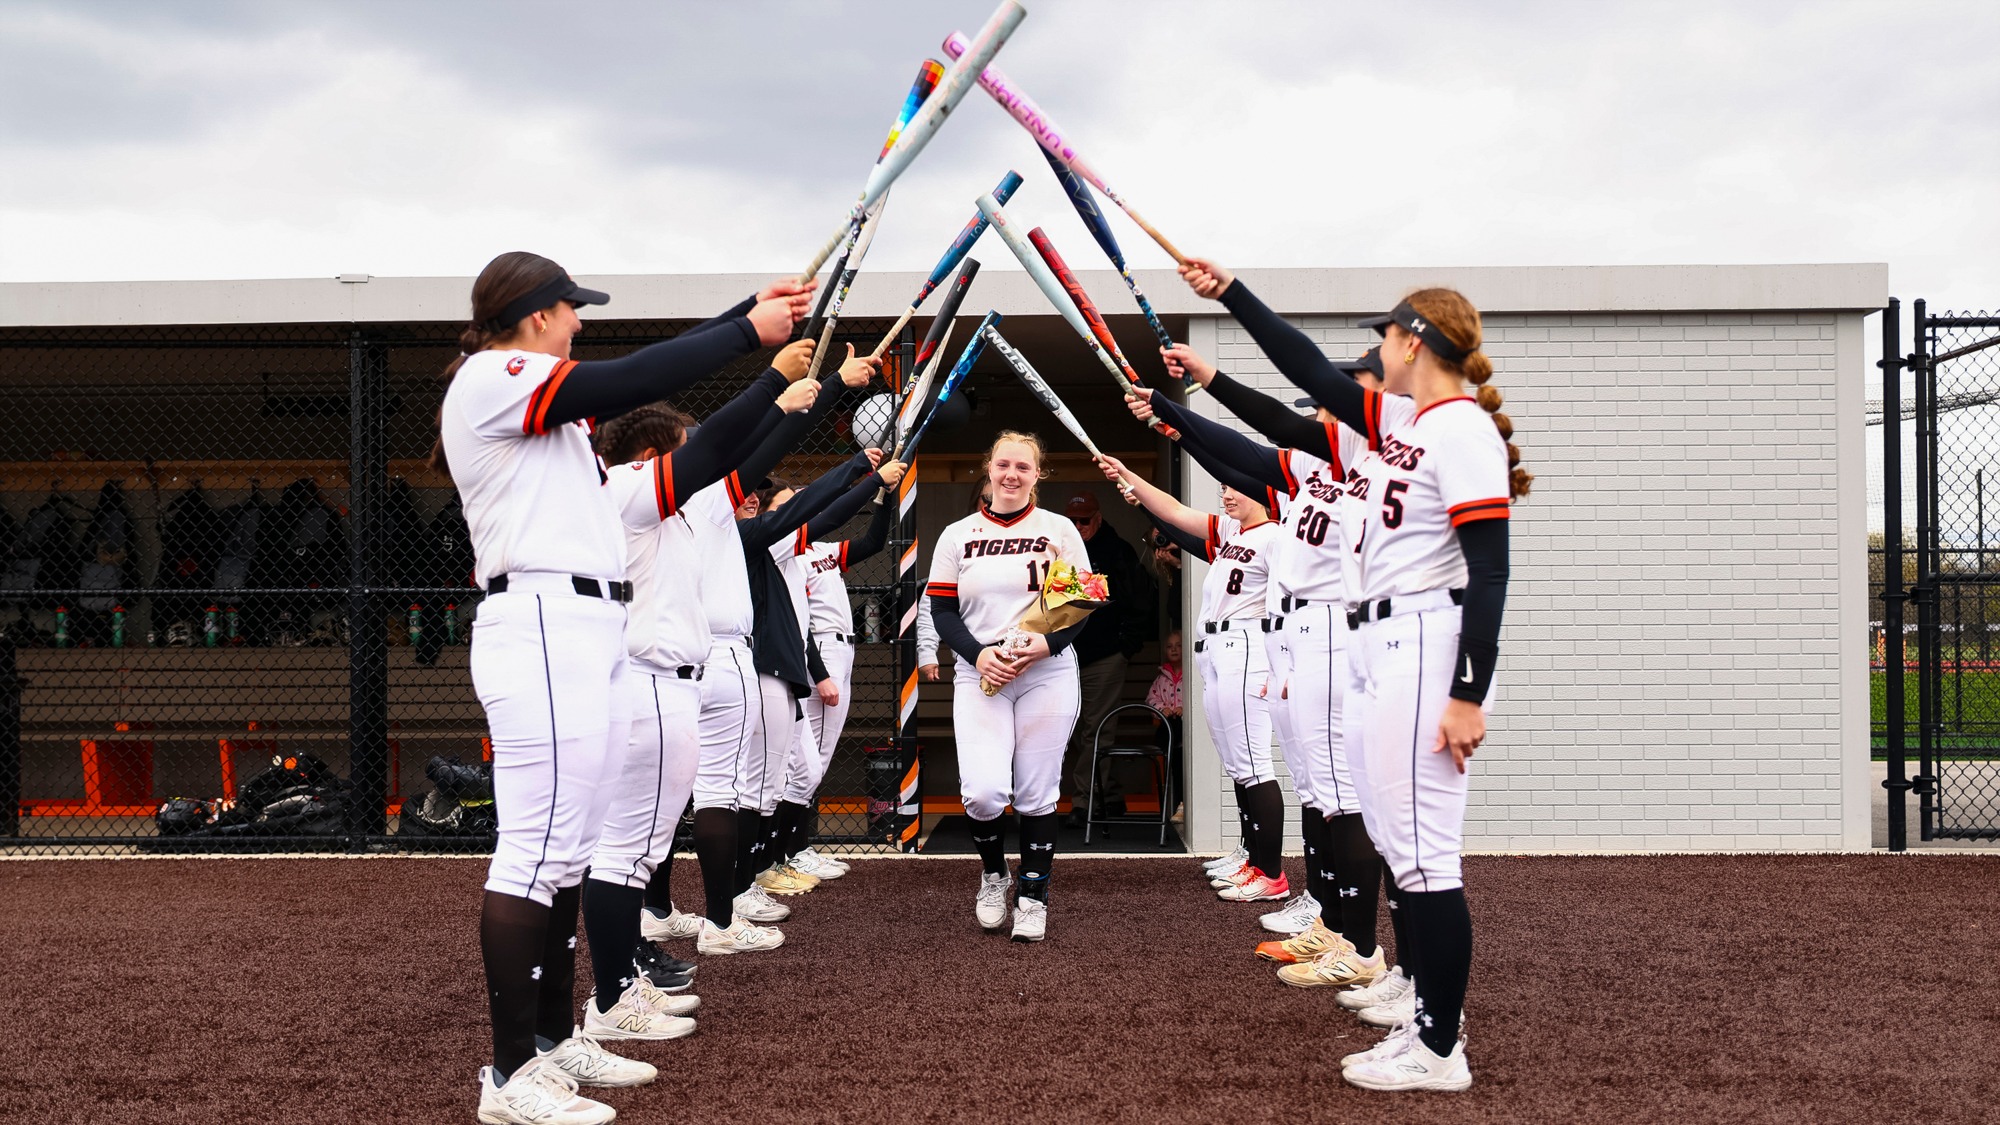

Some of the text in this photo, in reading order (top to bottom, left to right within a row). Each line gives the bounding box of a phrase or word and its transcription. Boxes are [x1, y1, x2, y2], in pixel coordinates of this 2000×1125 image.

[947, 38, 1063, 151] UNLIMITD
[986, 329, 1046, 394] EASTON
[1296, 504, 1331, 547] 20
[1382, 479, 1409, 530] 5
[963, 536, 1051, 559] TIGERS
[1226, 567, 1245, 596] 8
